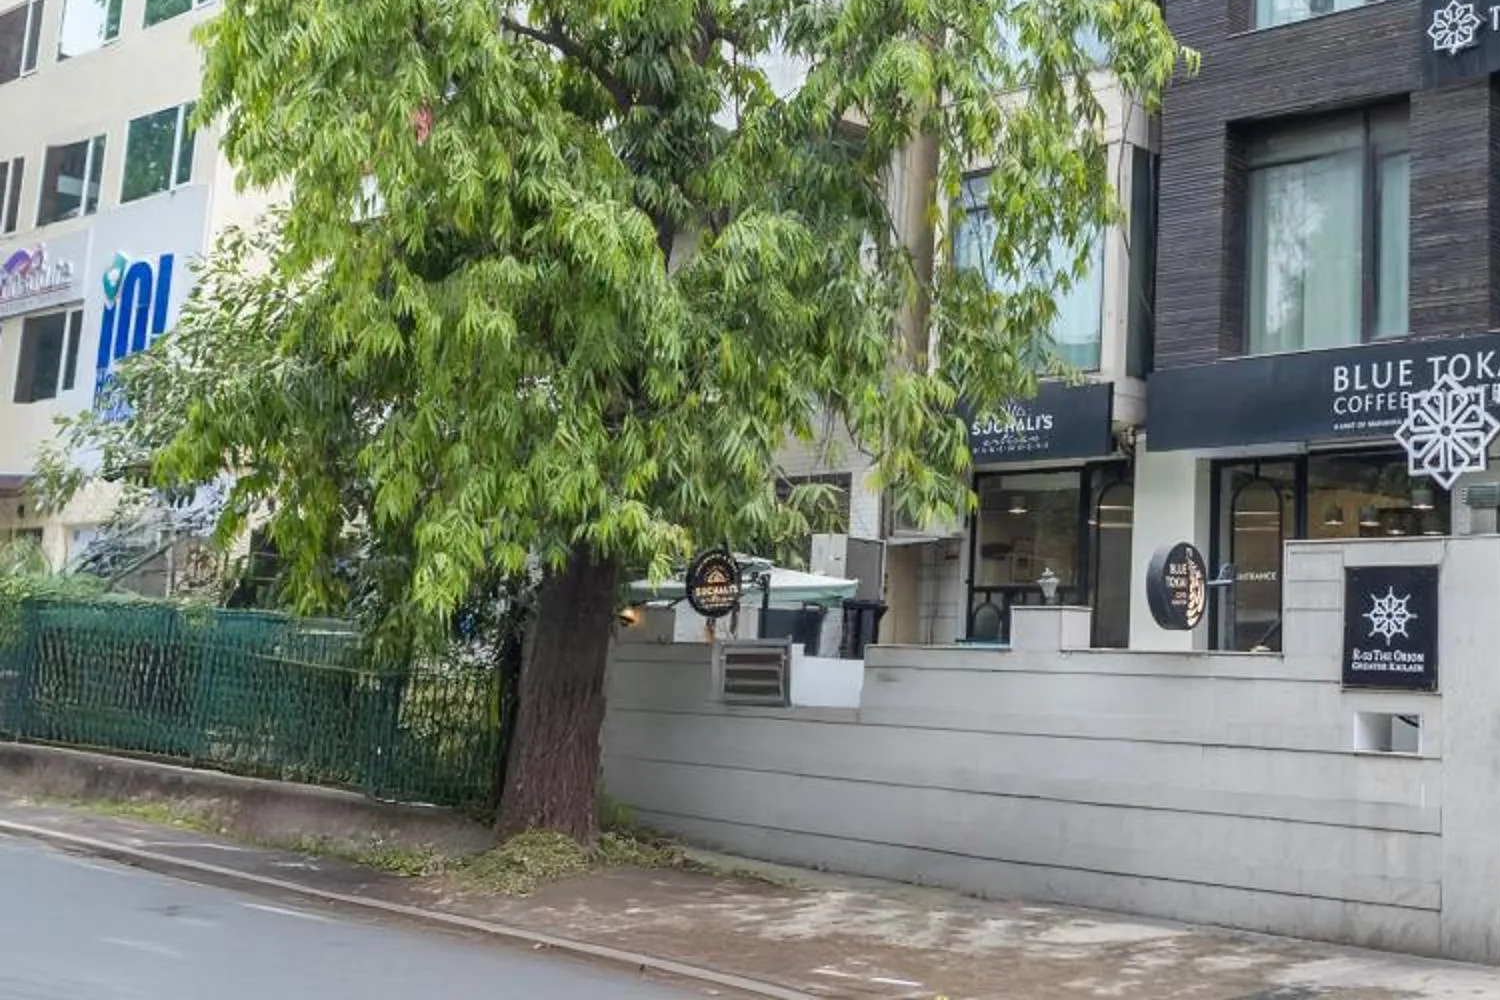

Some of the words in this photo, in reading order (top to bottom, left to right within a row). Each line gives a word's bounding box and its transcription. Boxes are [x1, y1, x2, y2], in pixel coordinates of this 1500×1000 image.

[1333, 359, 1413, 392] BLUE
[1333, 391, 1411, 415] COFFEE
[1169, 563, 1188, 575] BLUE
